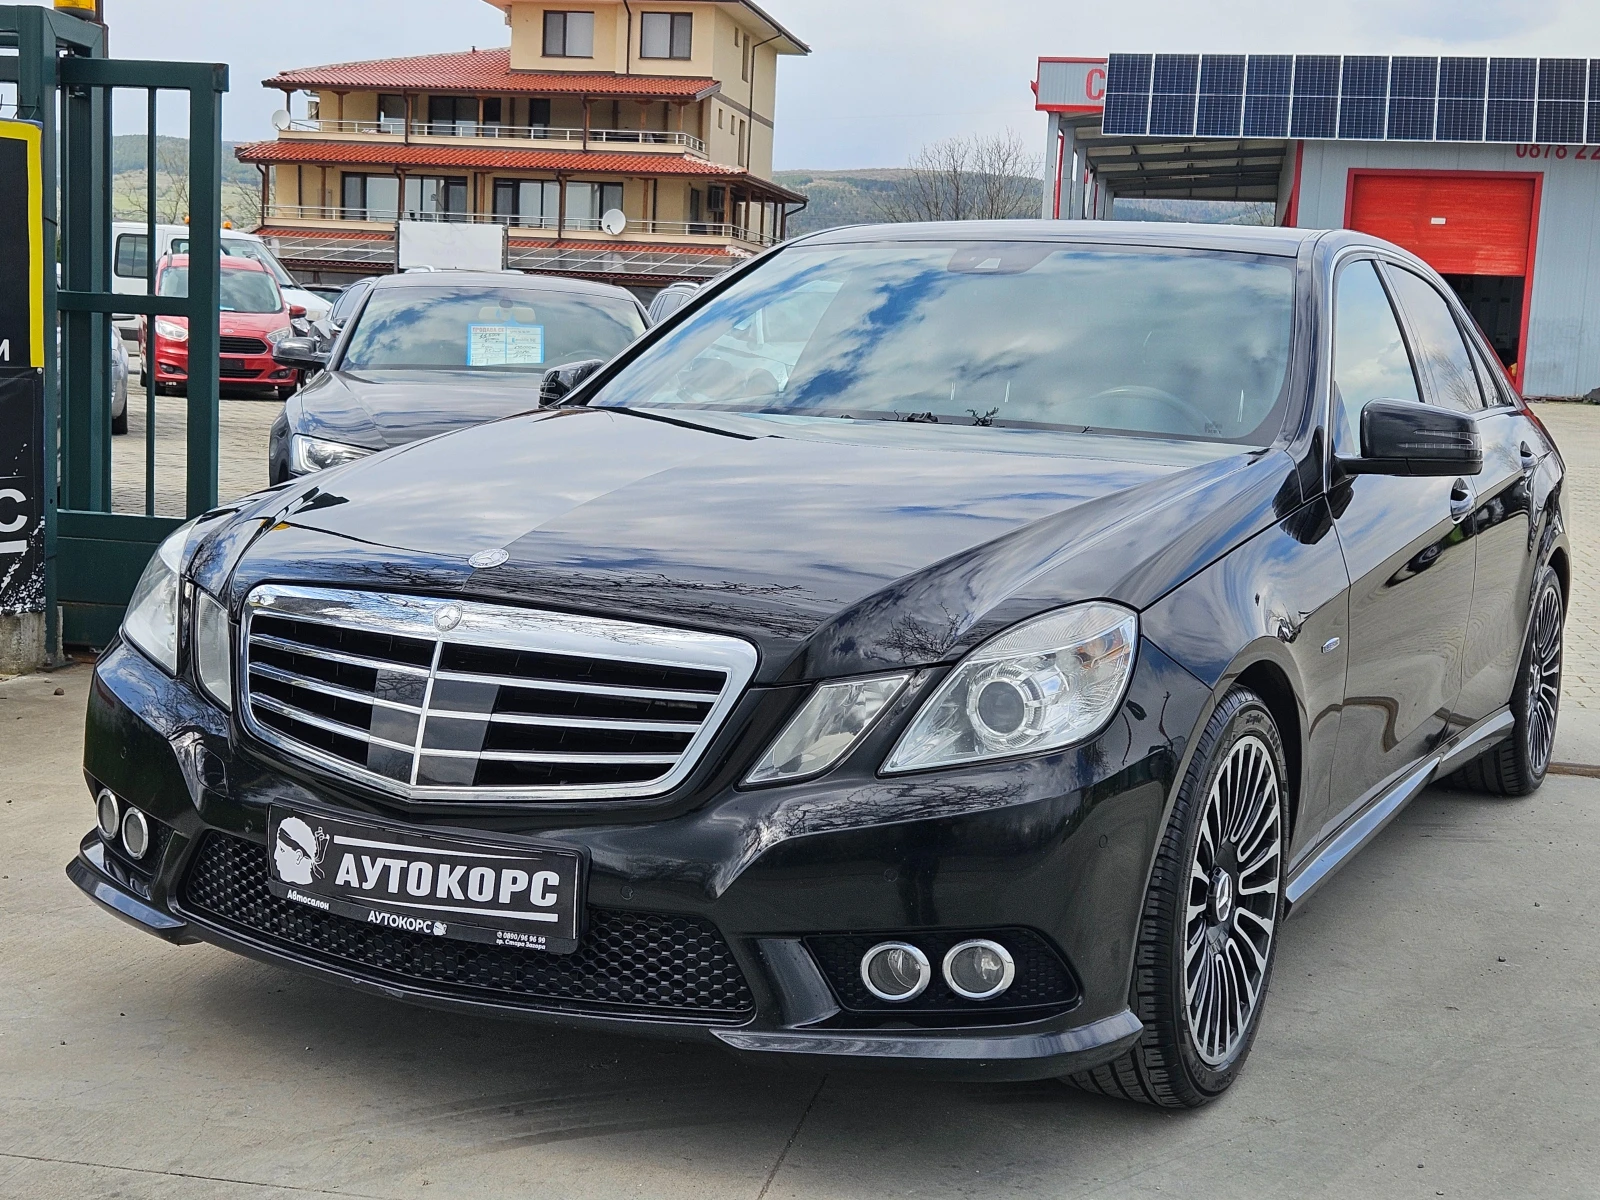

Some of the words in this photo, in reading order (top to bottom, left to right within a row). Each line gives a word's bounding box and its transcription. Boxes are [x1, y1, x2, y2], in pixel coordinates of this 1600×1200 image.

[335, 853, 560, 907] АУТОКОРС
[287, 889, 330, 911] Автосалон
[367, 910, 432, 933] АУТОКОРС
[525, 941, 546, 950] Загора
